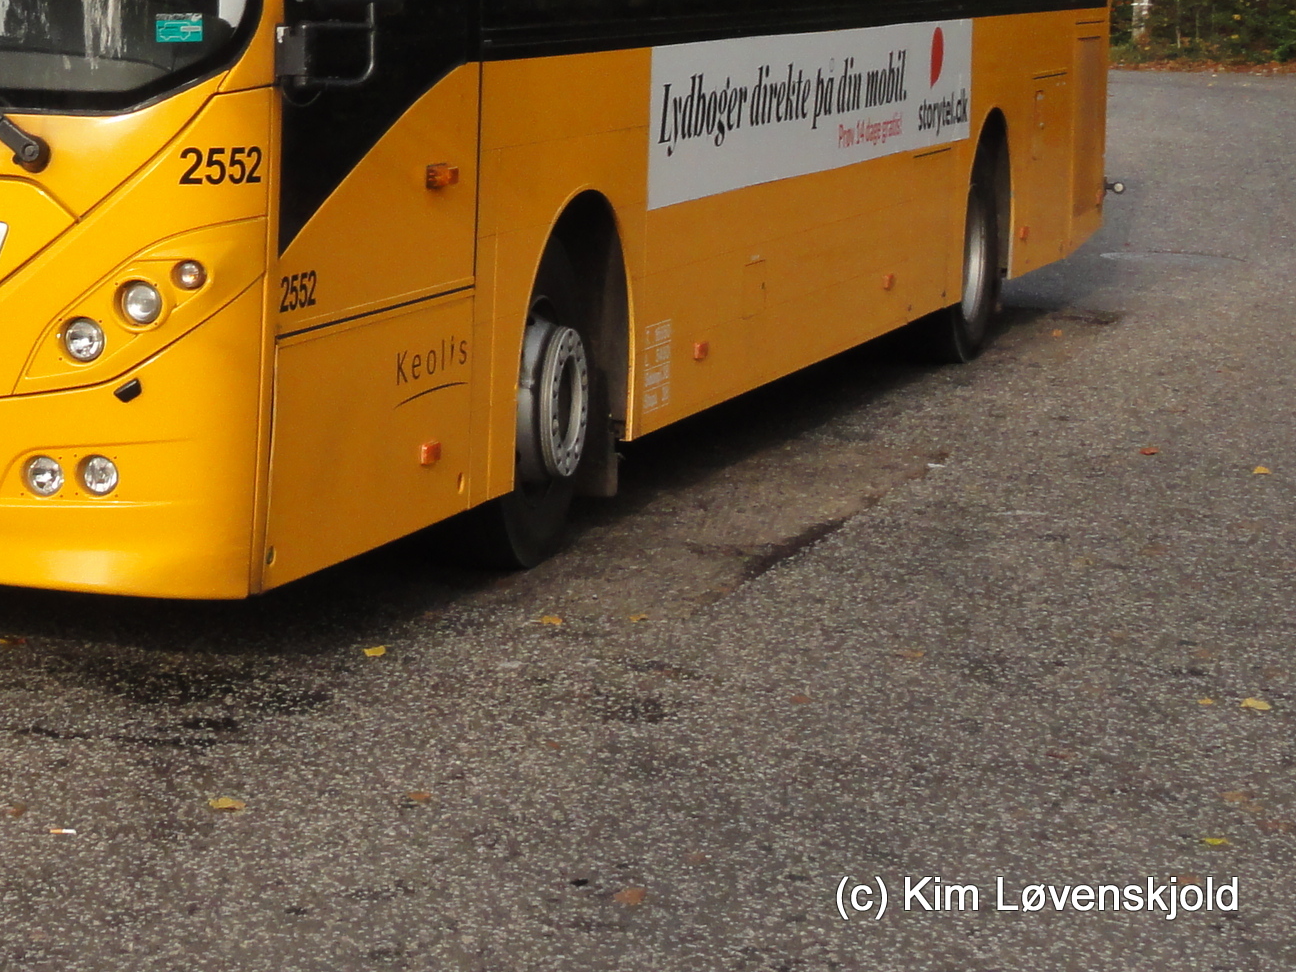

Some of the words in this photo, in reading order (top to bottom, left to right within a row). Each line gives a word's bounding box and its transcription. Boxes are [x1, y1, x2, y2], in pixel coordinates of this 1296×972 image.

[749, 61, 811, 127] direkte
[811, 57, 834, 130] på
[836, 56, 862, 115] din
[864, 49, 907, 109] mobil.
[918, 87, 968, 137] storytel.dk
[179, 145, 262, 185] 2552
[279, 269, 317, 313] 2552
[395, 335, 469, 386] Keolis
